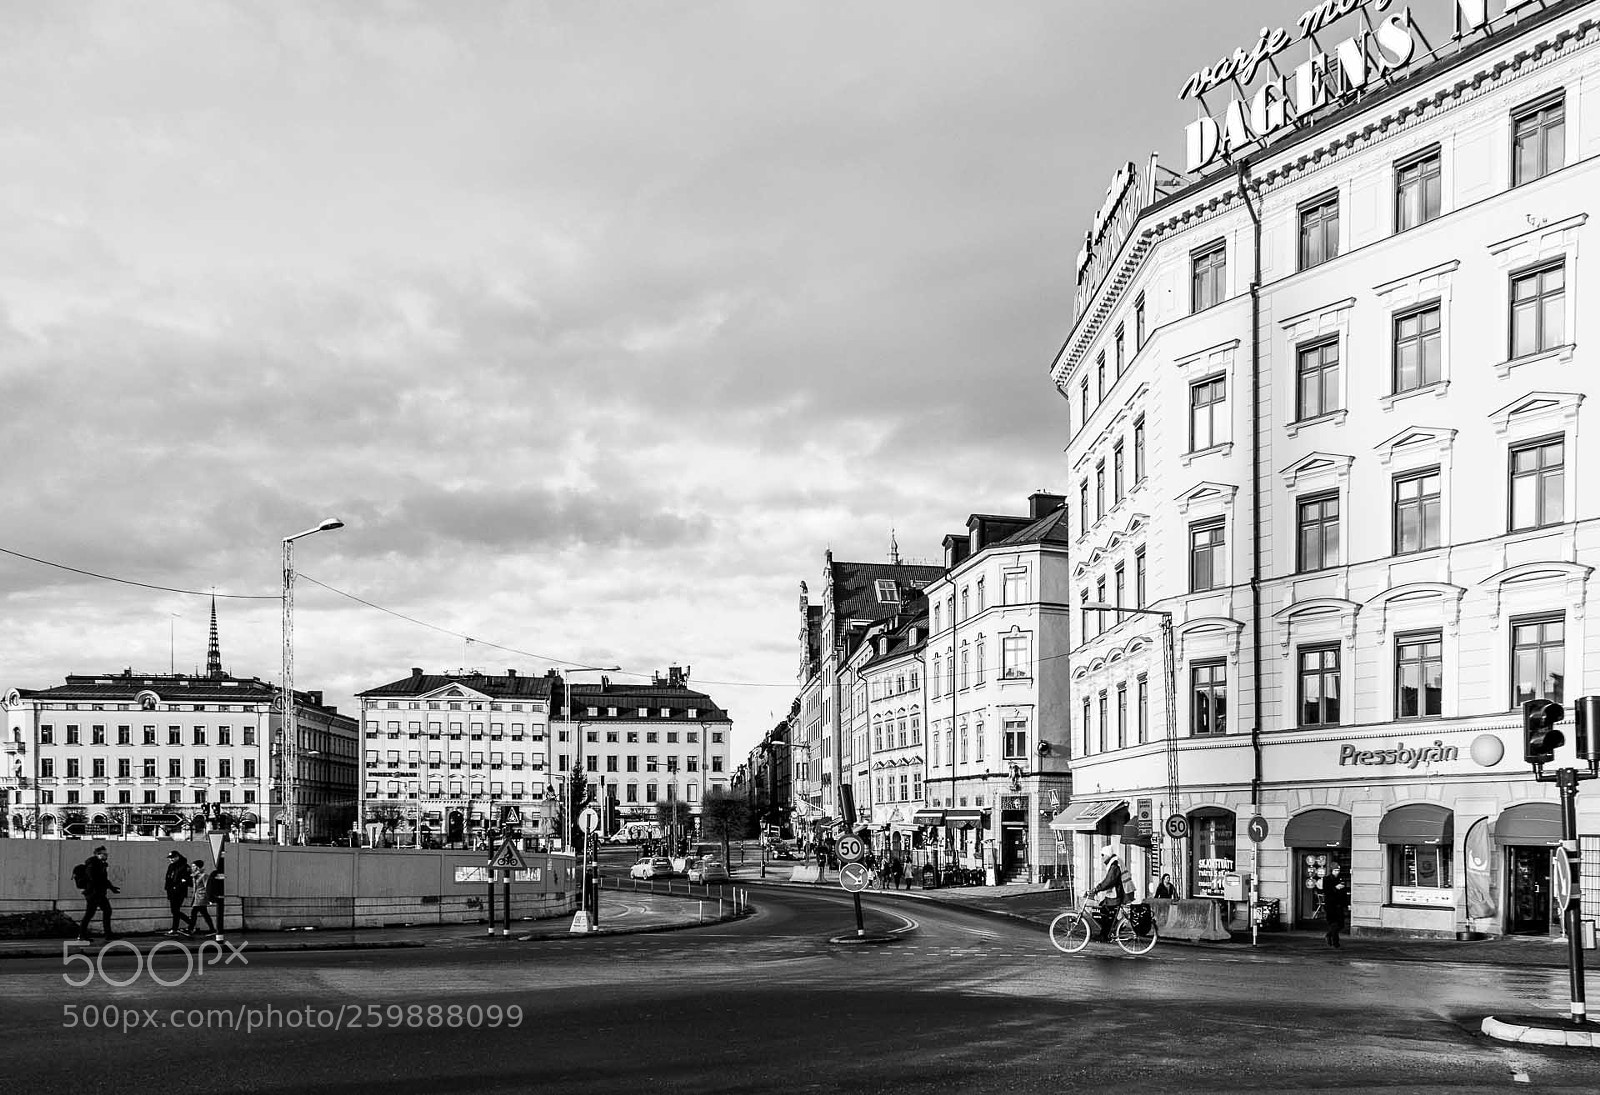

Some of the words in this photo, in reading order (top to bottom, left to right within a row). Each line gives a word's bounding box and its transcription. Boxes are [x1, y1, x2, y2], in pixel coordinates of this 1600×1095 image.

[1178, 27, 1291, 100] varje
[1185, 6, 1414, 174] DAGENS
[1339, 740, 1459, 770] Pressbyrån
[1170, 820, 1186, 833] 50
[840, 841, 860, 856] 50
